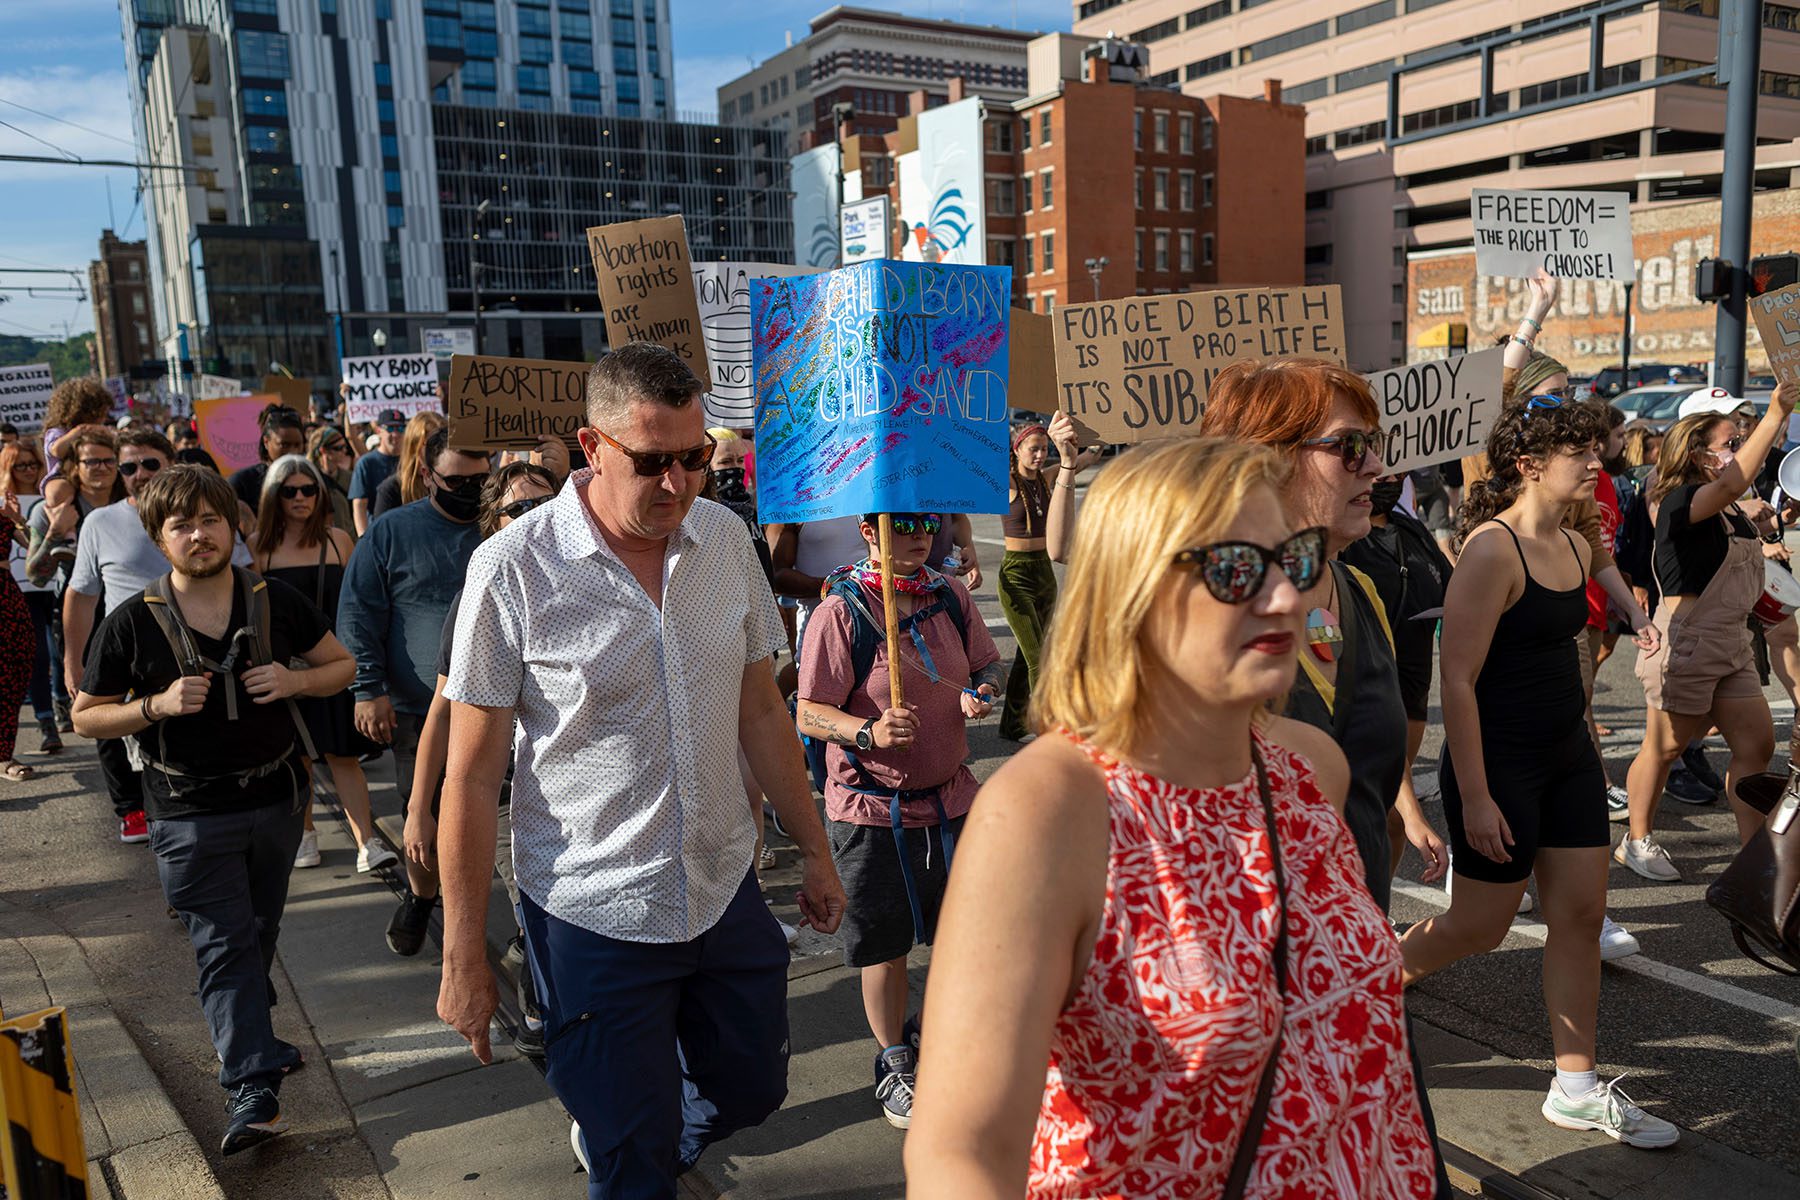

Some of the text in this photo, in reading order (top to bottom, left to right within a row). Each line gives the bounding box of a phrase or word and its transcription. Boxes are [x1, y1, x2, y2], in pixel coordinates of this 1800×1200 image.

[593, 233, 681, 272] Abortion
[1477, 229, 1588, 251] THE RIGHT TO
[1544, 253, 1614, 279] CHOOSE!
[615, 265, 679, 298] rights
[764, 265, 1005, 328] A CHILD BORN
[1417, 285, 1465, 316] sam
[610, 304, 641, 324] are
[834, 312, 941, 370] IS NOT
[1074, 344, 1100, 369] IS
[1122, 336, 1172, 364] NOT
[348, 358, 433, 379] MY BODY
[348, 380, 437, 400] MY CHOICE
[756, 360, 1008, 425] A CHILD SAVED
[1062, 380, 1113, 417] IT'S
[1, 403, 30, 412] ONCE
[4, 413, 30, 422] FOR
[459, 398, 480, 417] IS
